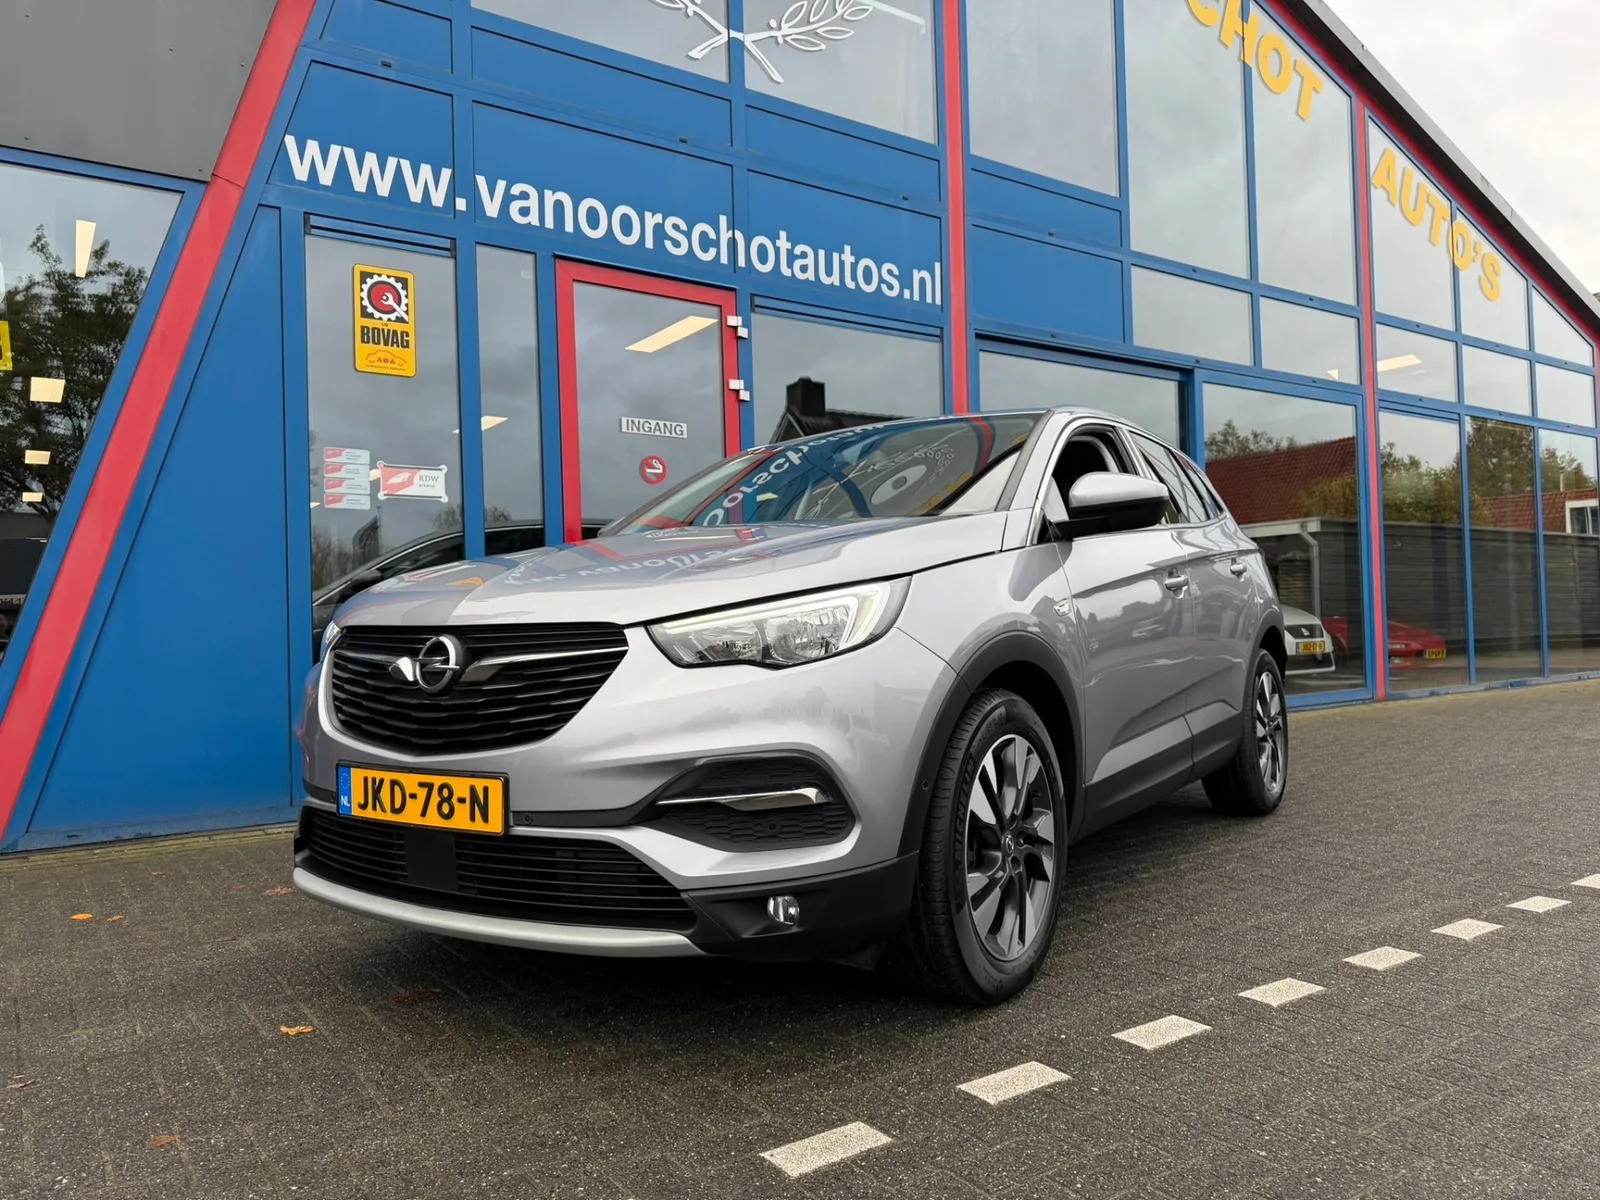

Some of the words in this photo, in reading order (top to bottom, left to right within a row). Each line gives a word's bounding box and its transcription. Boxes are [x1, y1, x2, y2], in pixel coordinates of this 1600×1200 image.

[284, 134, 942, 305] www.vanoorschotautos.nl
[1371, 147, 1502, 302] AUTO'S
[360, 325, 410, 349] BOVAG
[377, 357, 396, 365] ABA
[626, 418, 684, 436] INGANG
[418, 474, 439, 482] RDW
[340, 794, 350, 807] NL
[357, 775, 490, 824] JKD-78-N
[954, 755, 976, 861] MICHELIN
